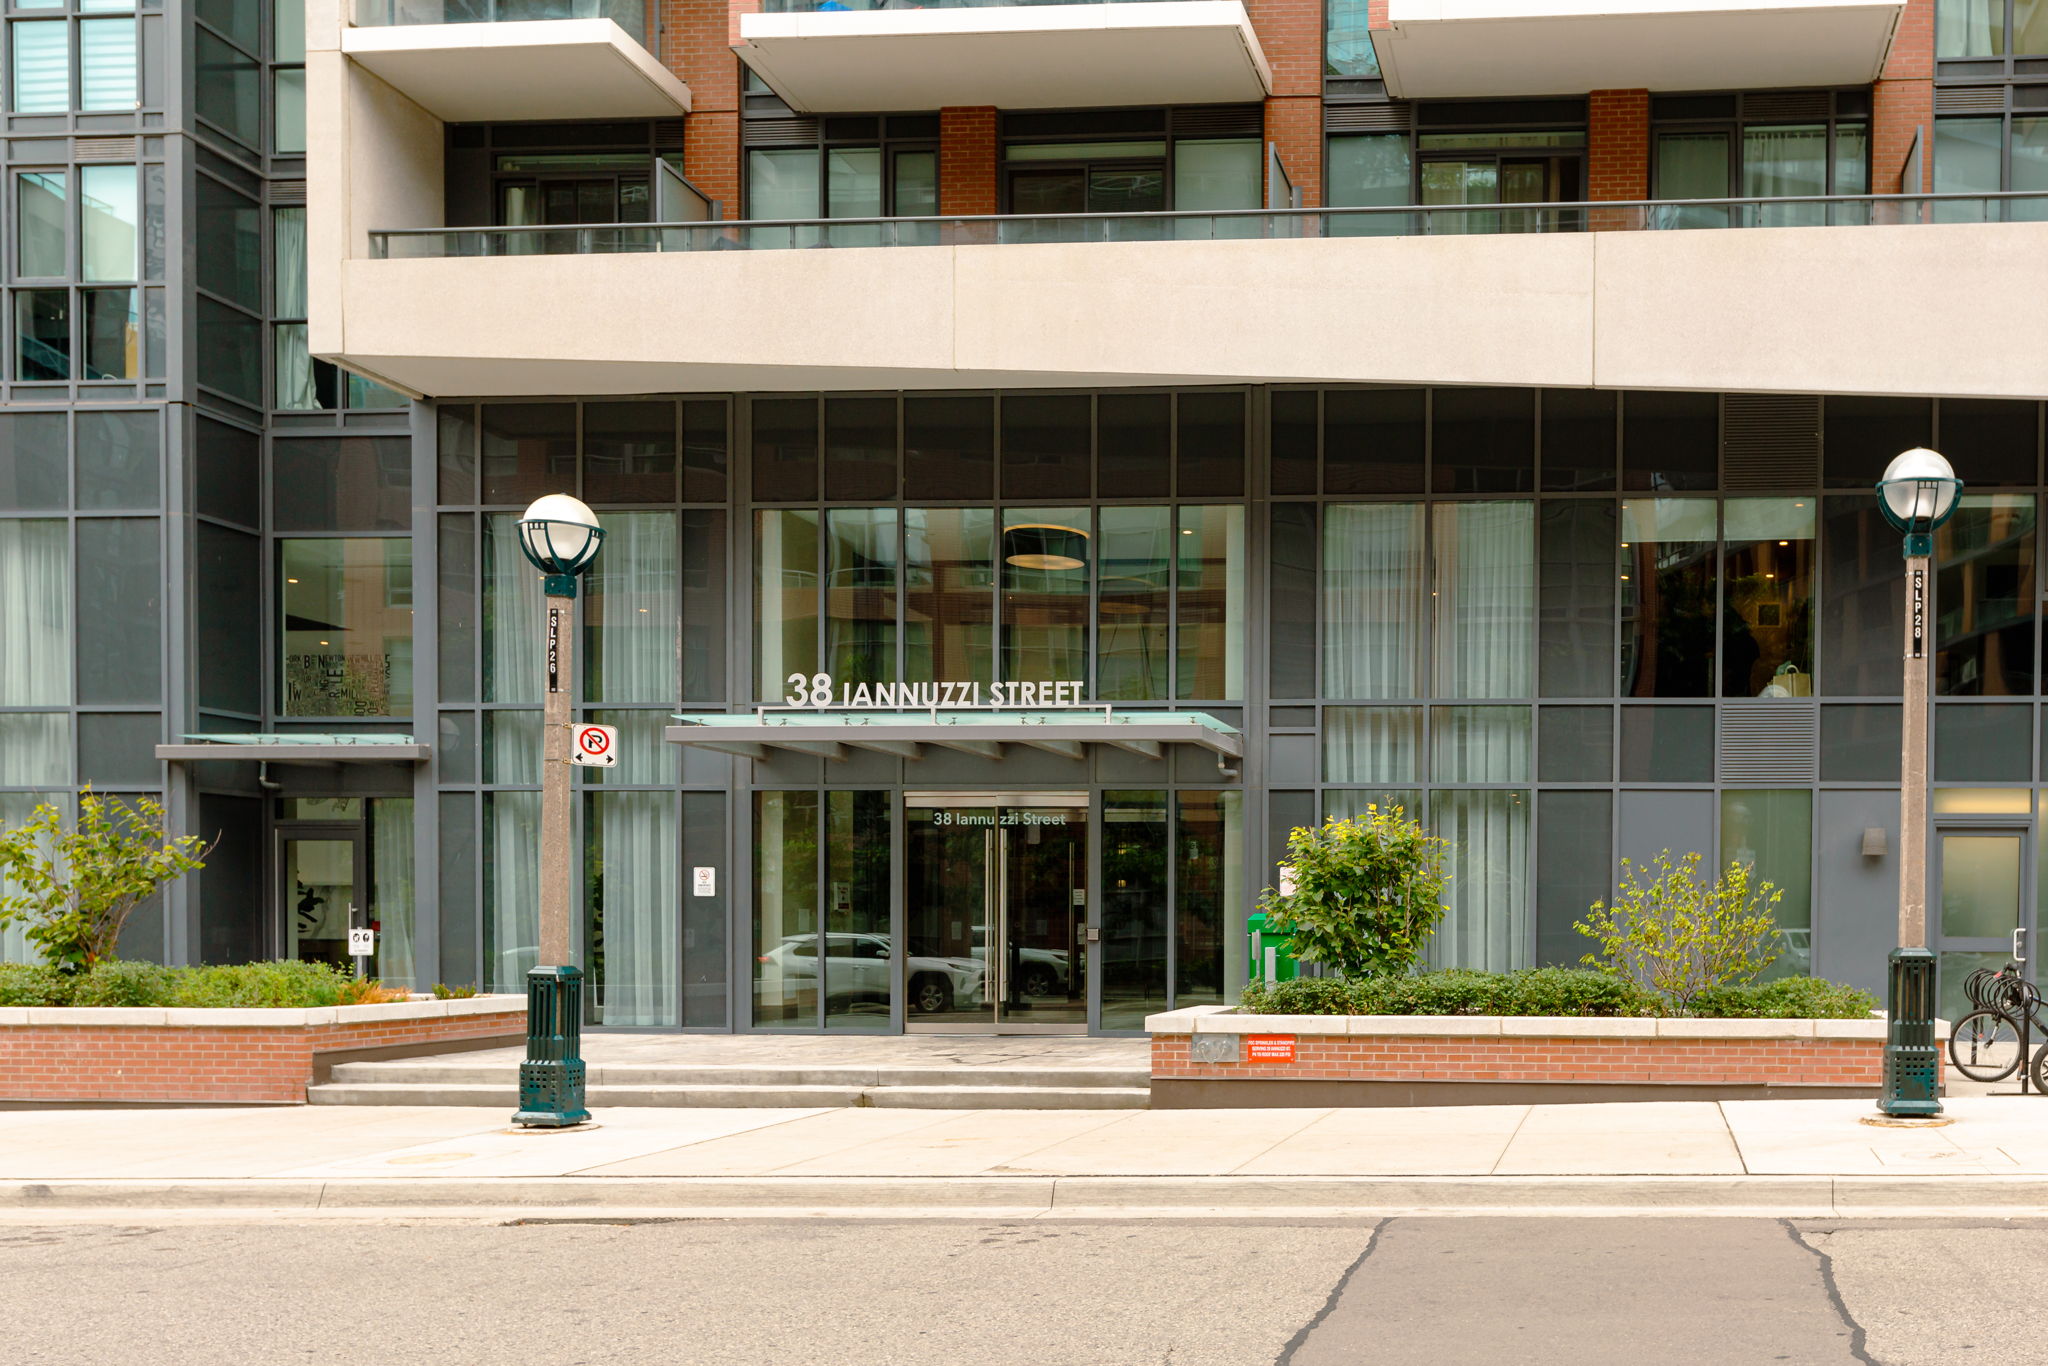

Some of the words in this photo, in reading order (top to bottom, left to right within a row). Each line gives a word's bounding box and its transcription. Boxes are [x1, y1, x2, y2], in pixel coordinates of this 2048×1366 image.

[1914, 577, 1922, 639] SLP28
[549, 616, 557, 673] SLP26
[786, 672, 833, 708] 38
[844, 681, 979, 707] IANNUZZI
[989, 681, 1084, 707] STREET
[933, 812, 952, 826] 38
[1023, 812, 1067, 826] Street
